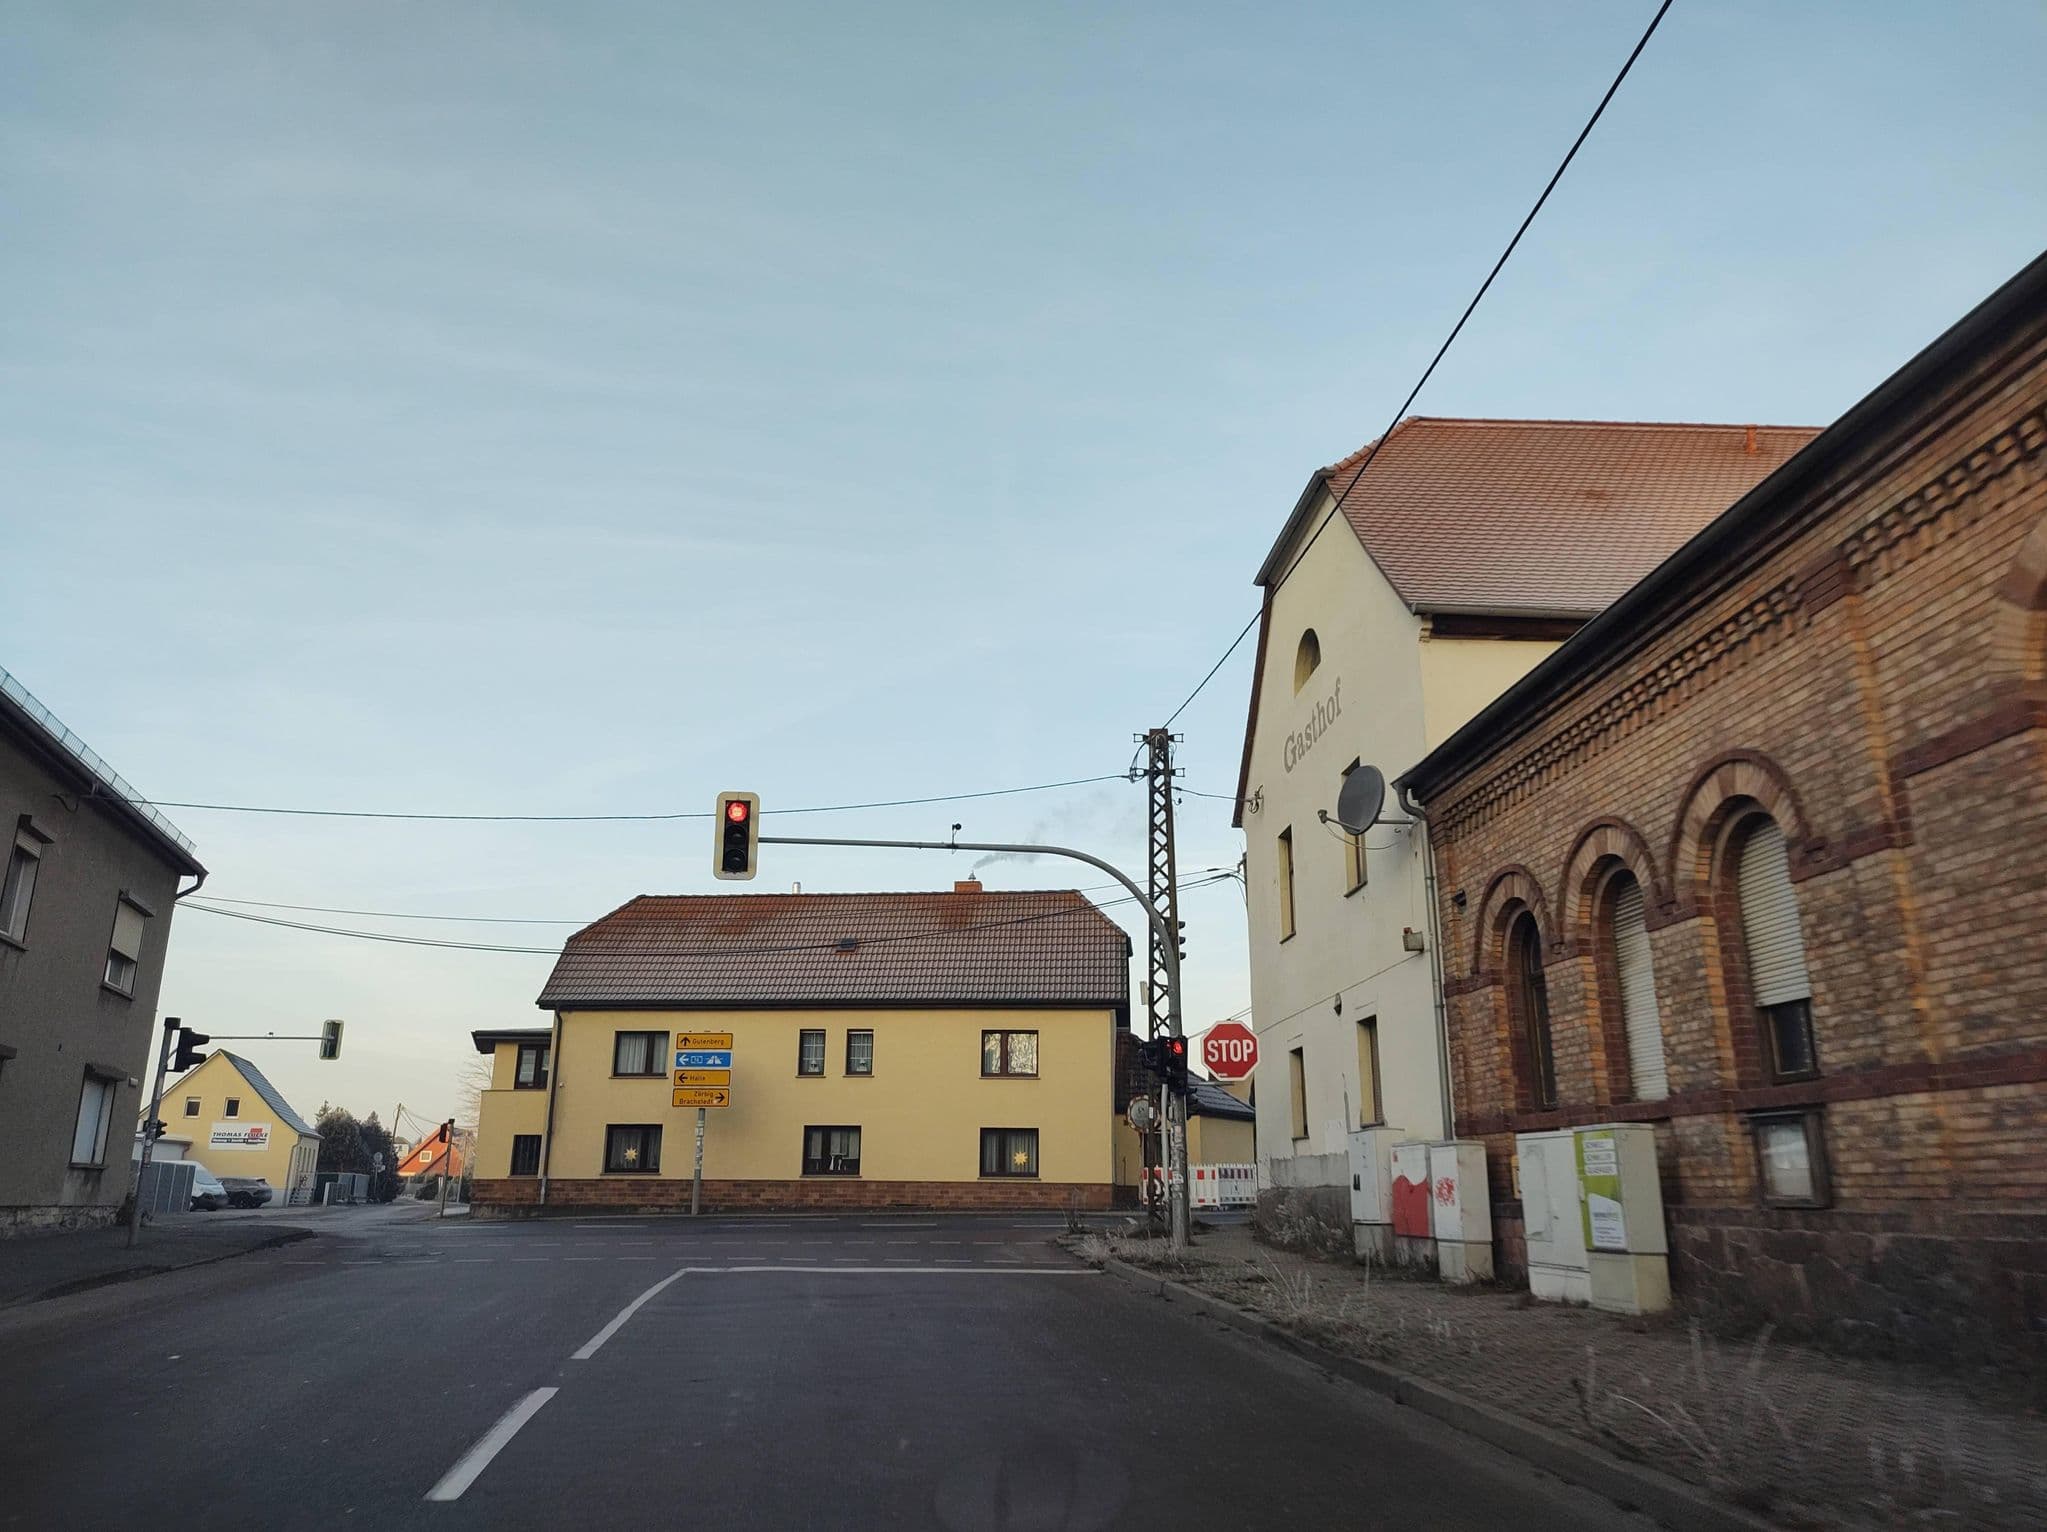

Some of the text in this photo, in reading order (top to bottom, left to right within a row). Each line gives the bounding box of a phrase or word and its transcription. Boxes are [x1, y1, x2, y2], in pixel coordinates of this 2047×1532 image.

[1284, 677, 1342, 773] Gasthof
[692, 1038, 724, 1046] Gutenberg
[1207, 1039, 1254, 1063] STOP
